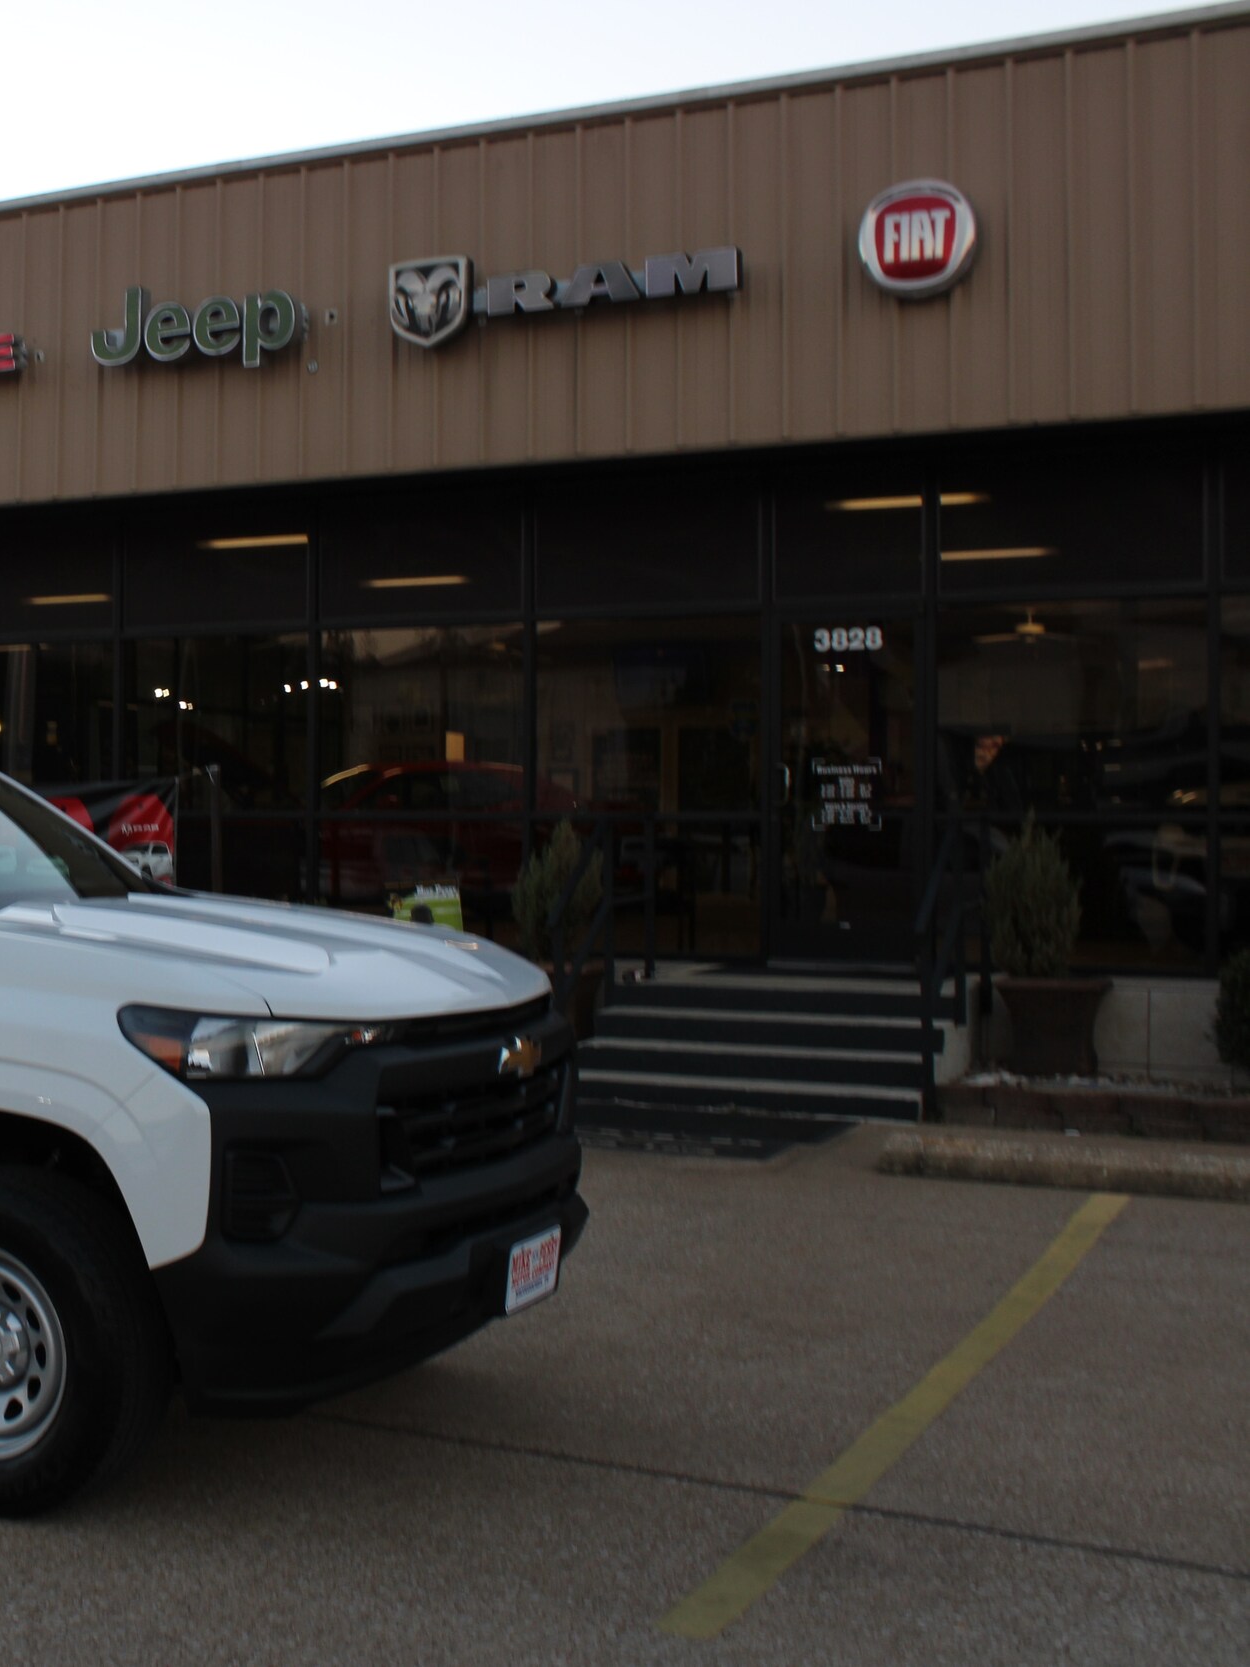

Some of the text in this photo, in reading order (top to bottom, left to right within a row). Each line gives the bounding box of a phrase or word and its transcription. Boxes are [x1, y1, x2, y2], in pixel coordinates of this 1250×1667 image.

[883, 208, 950, 264] FIAT
[487, 246, 739, 317] RAM
[91, 286, 296, 368] Jeep
